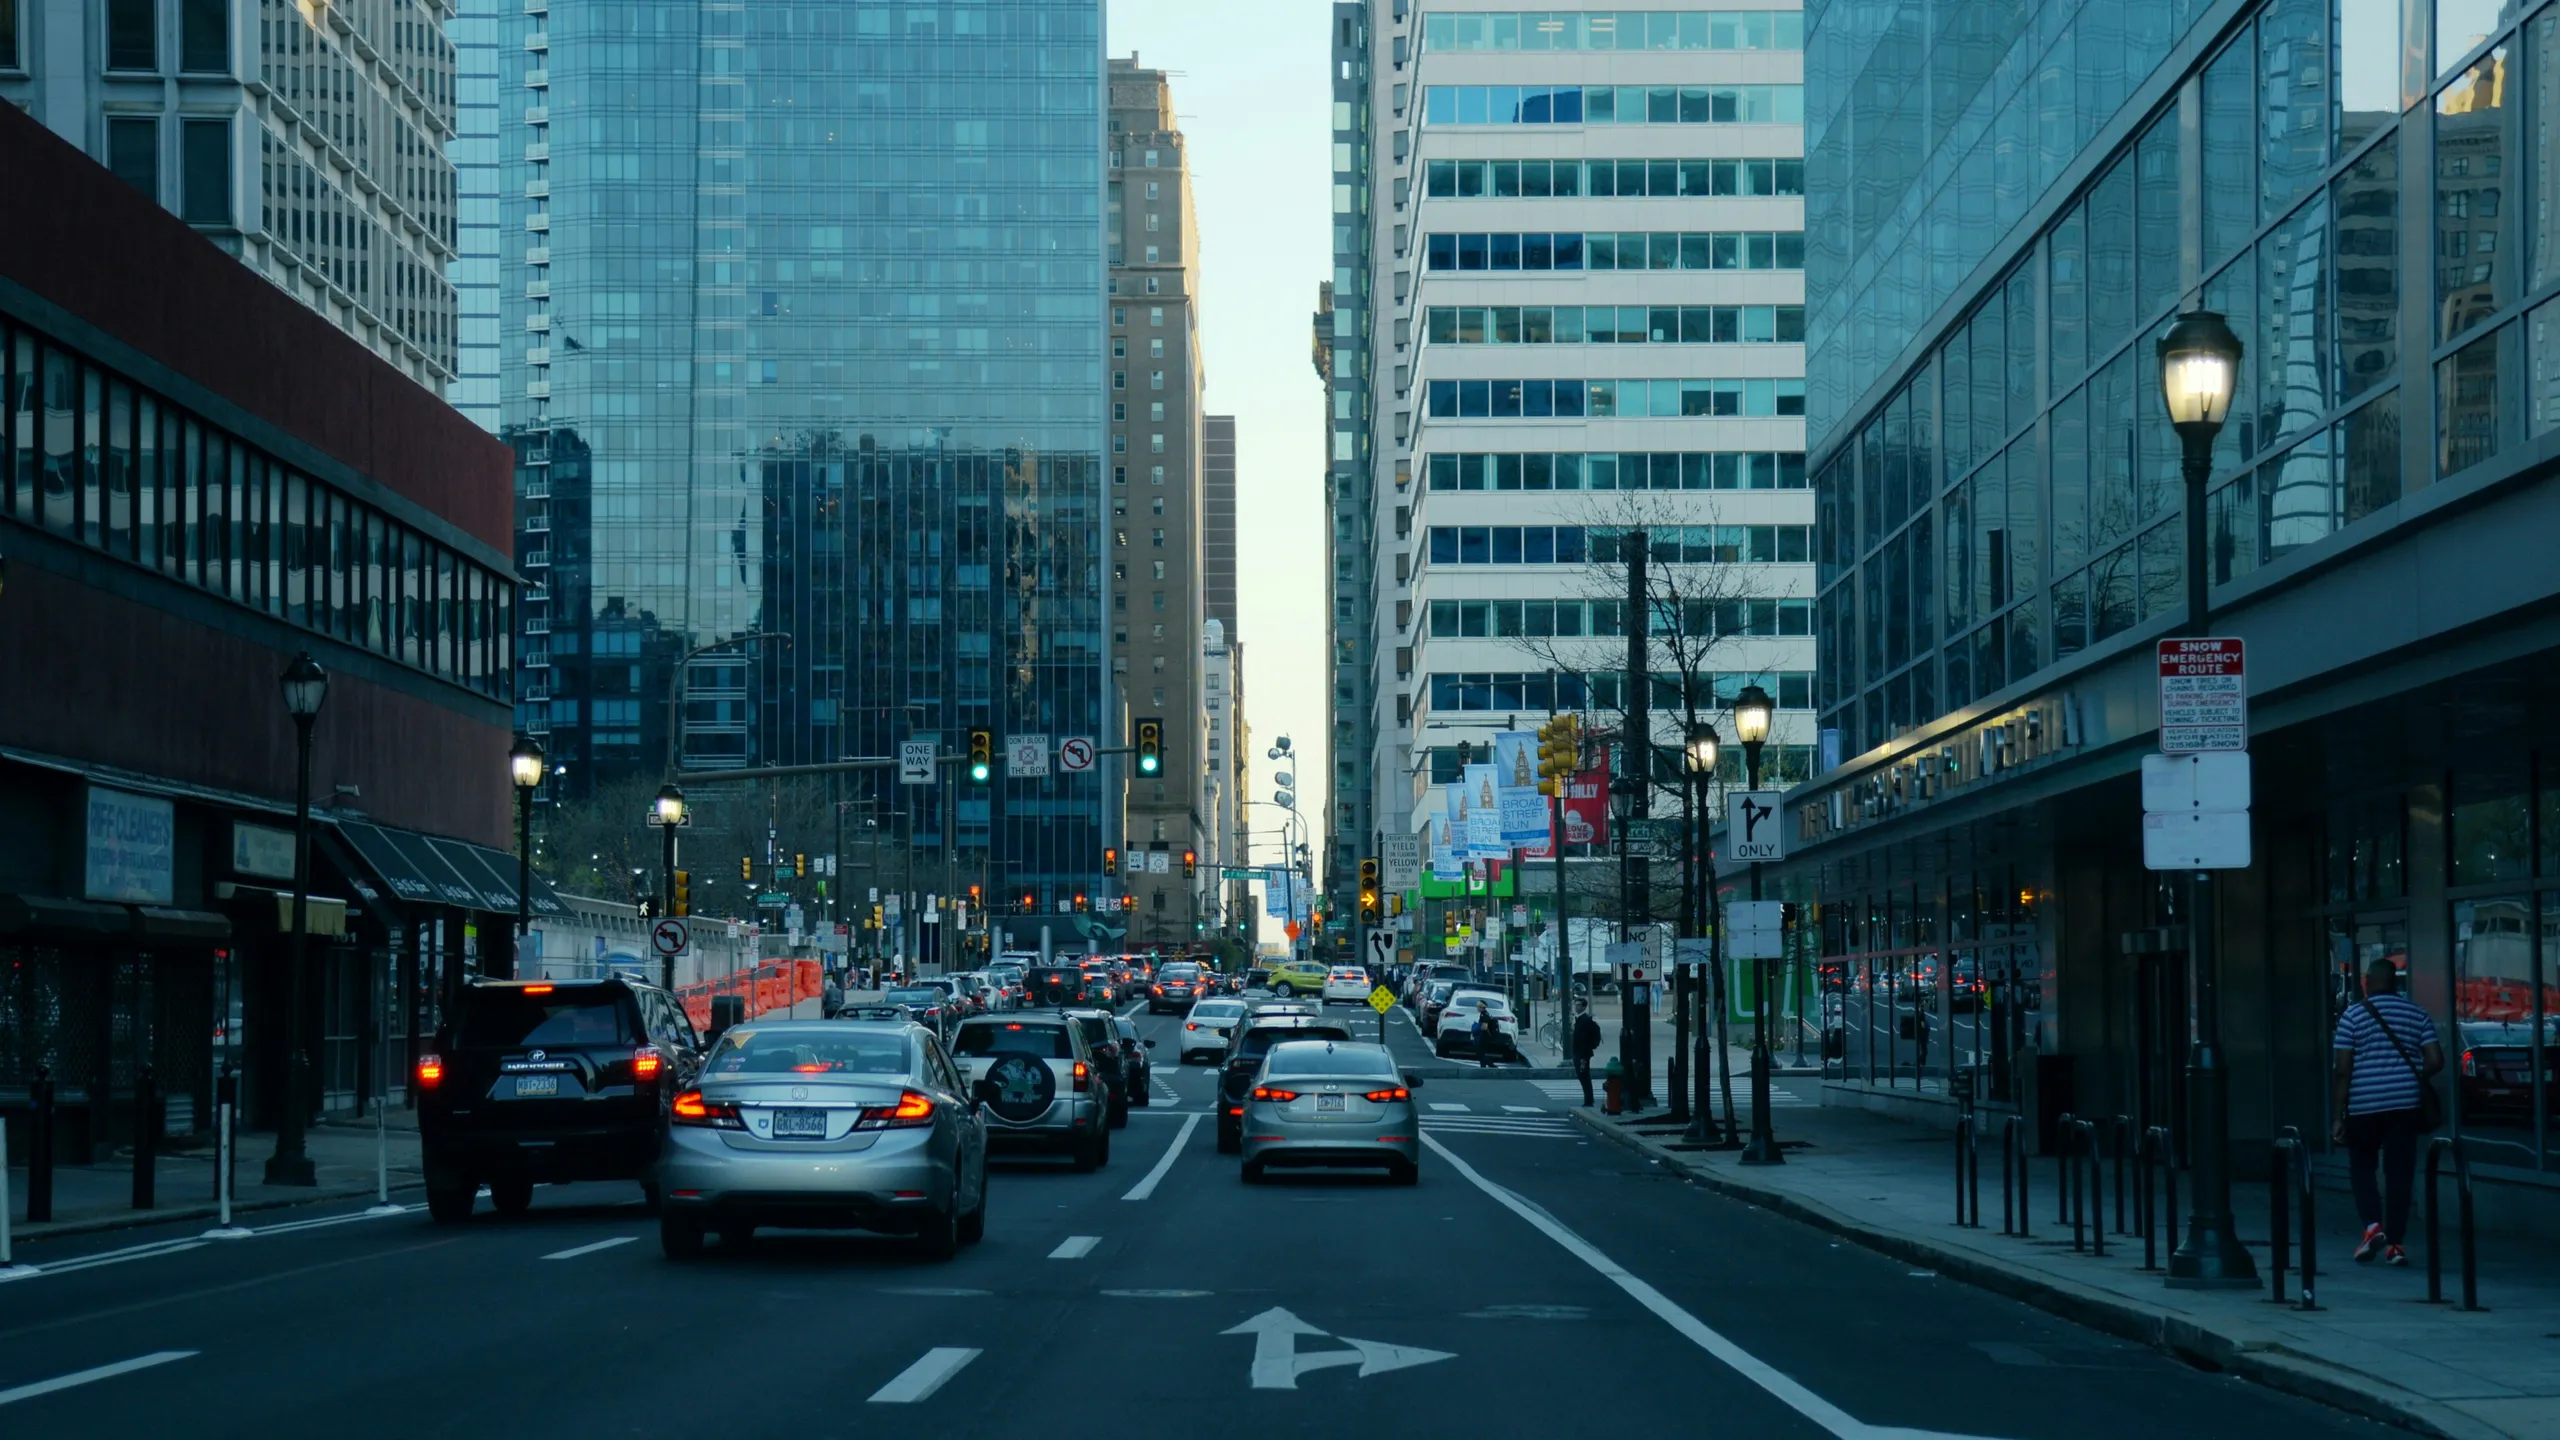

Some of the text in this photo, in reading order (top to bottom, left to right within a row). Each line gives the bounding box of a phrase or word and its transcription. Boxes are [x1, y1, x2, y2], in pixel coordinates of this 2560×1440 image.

[2179, 642, 2222, 652] SNOW
[2160, 653, 2240, 664] EMERGENCY
[2178, 664, 2224, 674] ROUTE
[2164, 709, 2197, 717] VEHICLES
[1027, 736, 1046, 744] BLOCK
[2165, 733, 2240, 741] INFORMATION
[905, 745, 930, 754] ONE
[905, 756, 930, 766] WAY
[1011, 766, 1047, 775] THE BOX
[1502, 797, 1544, 809] BROAD
[1502, 808, 1544, 820] STREET
[117, 805, 170, 847] CLEANERS
[1470, 818, 1501, 826] BROA
[1503, 820, 1529, 830] RUN
[1470, 826, 1500, 835] STREE
[1567, 824, 1589, 832] LOVE
[1470, 835, 1492, 843] RUN
[1567, 832, 1589, 840] PARK
[1391, 842, 1415, 851] YIELD
[1738, 844, 1775, 857] ONLY
[1388, 858, 1419, 867] YELLOW
[1628, 931, 1647, 943] NO
[1638, 960, 1658, 969] RED
